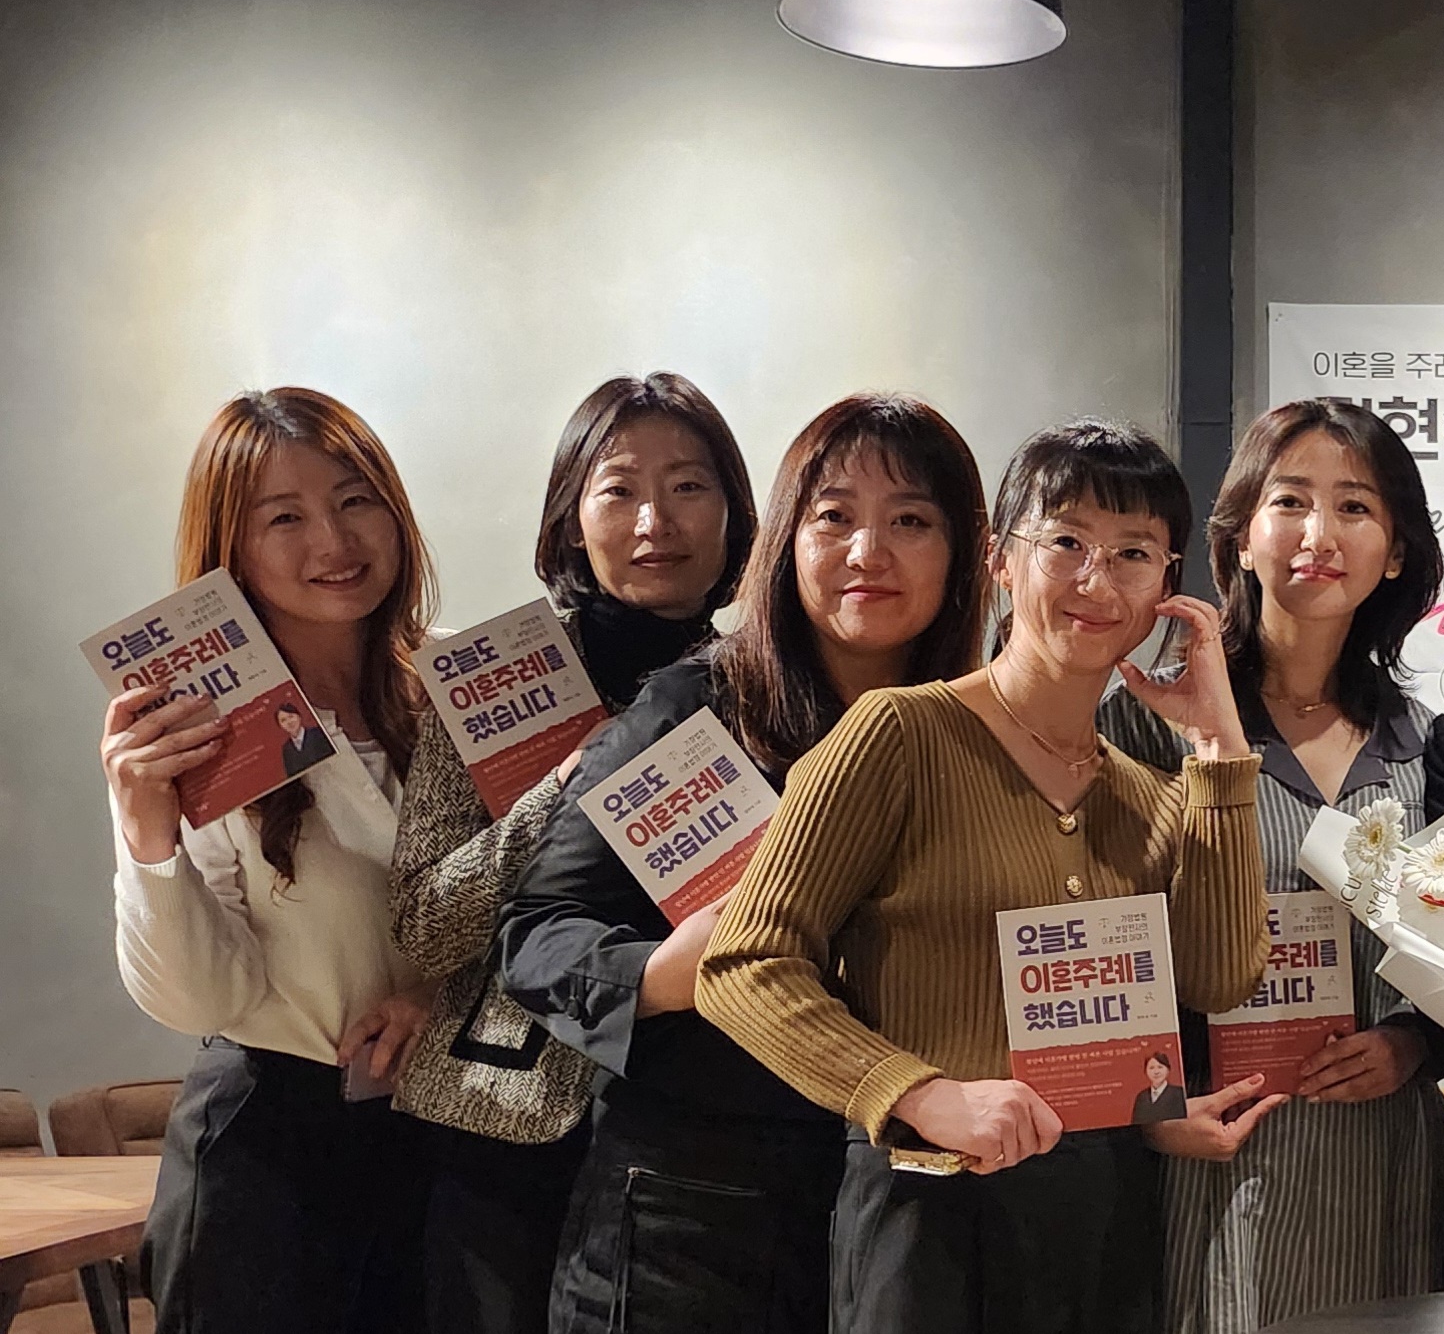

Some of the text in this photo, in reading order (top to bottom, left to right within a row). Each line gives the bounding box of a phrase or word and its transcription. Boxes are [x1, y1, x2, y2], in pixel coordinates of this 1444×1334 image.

[1313, 351, 1396, 379] 이혼을
[102, 617, 175, 671] 오늘도
[433, 636, 500, 683] 오늘도
[450, 644, 567, 710] 이혼주례를
[462, 683, 558, 743] 했습니다
[603, 764, 670, 823] 오늘도
[626, 754, 741, 847] 이혼주례를
[645, 800, 739, 878] 했습니다
[1017, 919, 1087, 956] 오늘도
[1267, 939, 1338, 970] 주례를
[1021, 950, 1155, 993] 이혼주례를
[1023, 993, 1130, 1031] 했습니다
